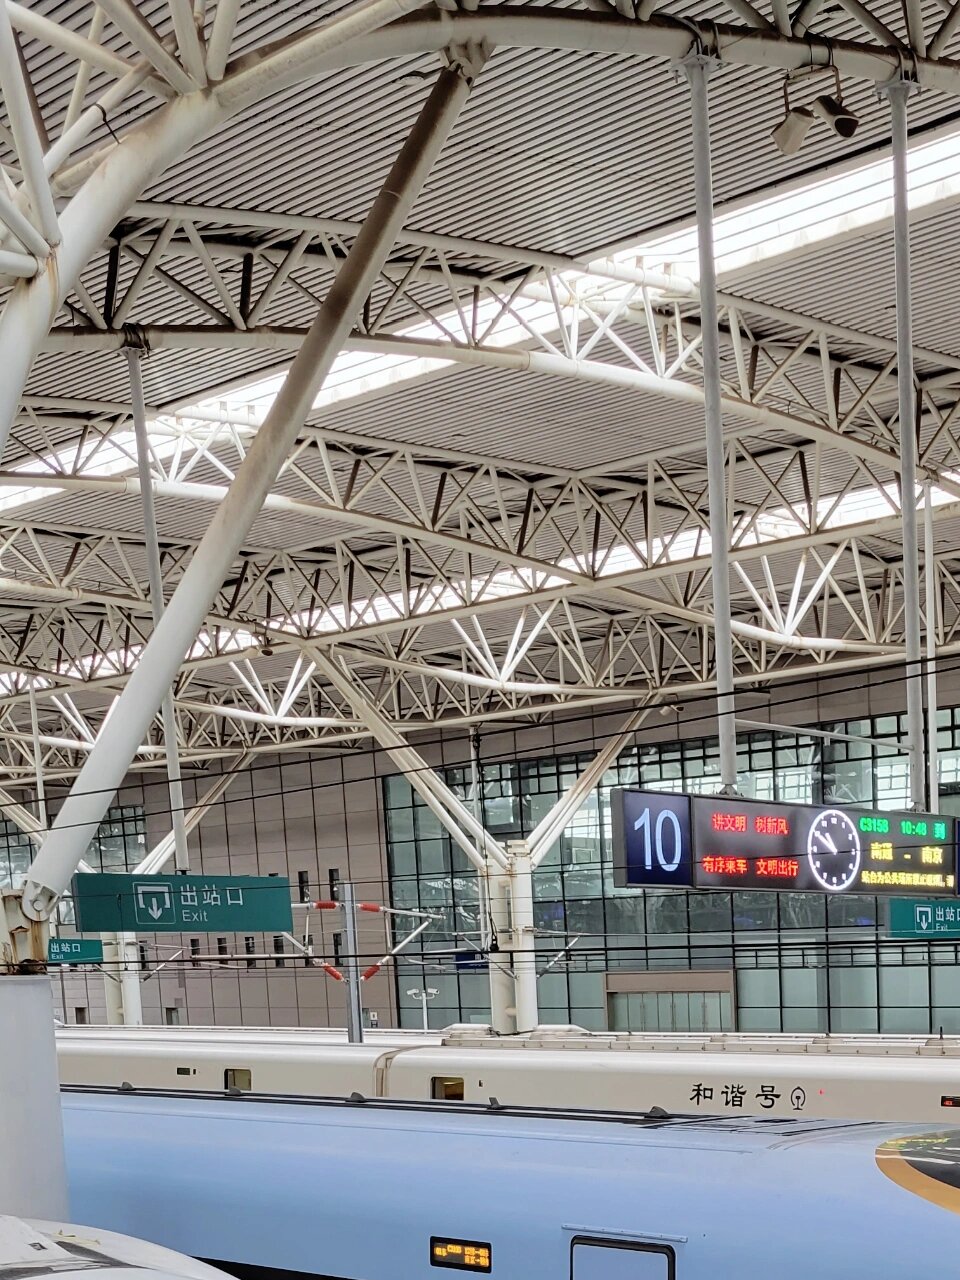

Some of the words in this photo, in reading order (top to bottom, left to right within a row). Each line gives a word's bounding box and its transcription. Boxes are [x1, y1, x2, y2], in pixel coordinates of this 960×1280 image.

[712, 814, 747, 832] 讲文明
[755, 816, 788, 835] 树新风
[634, 808, 682, 872] 10
[702, 856, 748, 874] 有序乘车
[756, 859, 798, 877] 文明出行
[180, 884, 243, 906] 出站口
[182, 909, 208, 922] Exit
[50, 942, 81, 953] 出站口
[689, 1082, 781, 1109] 和谐号
